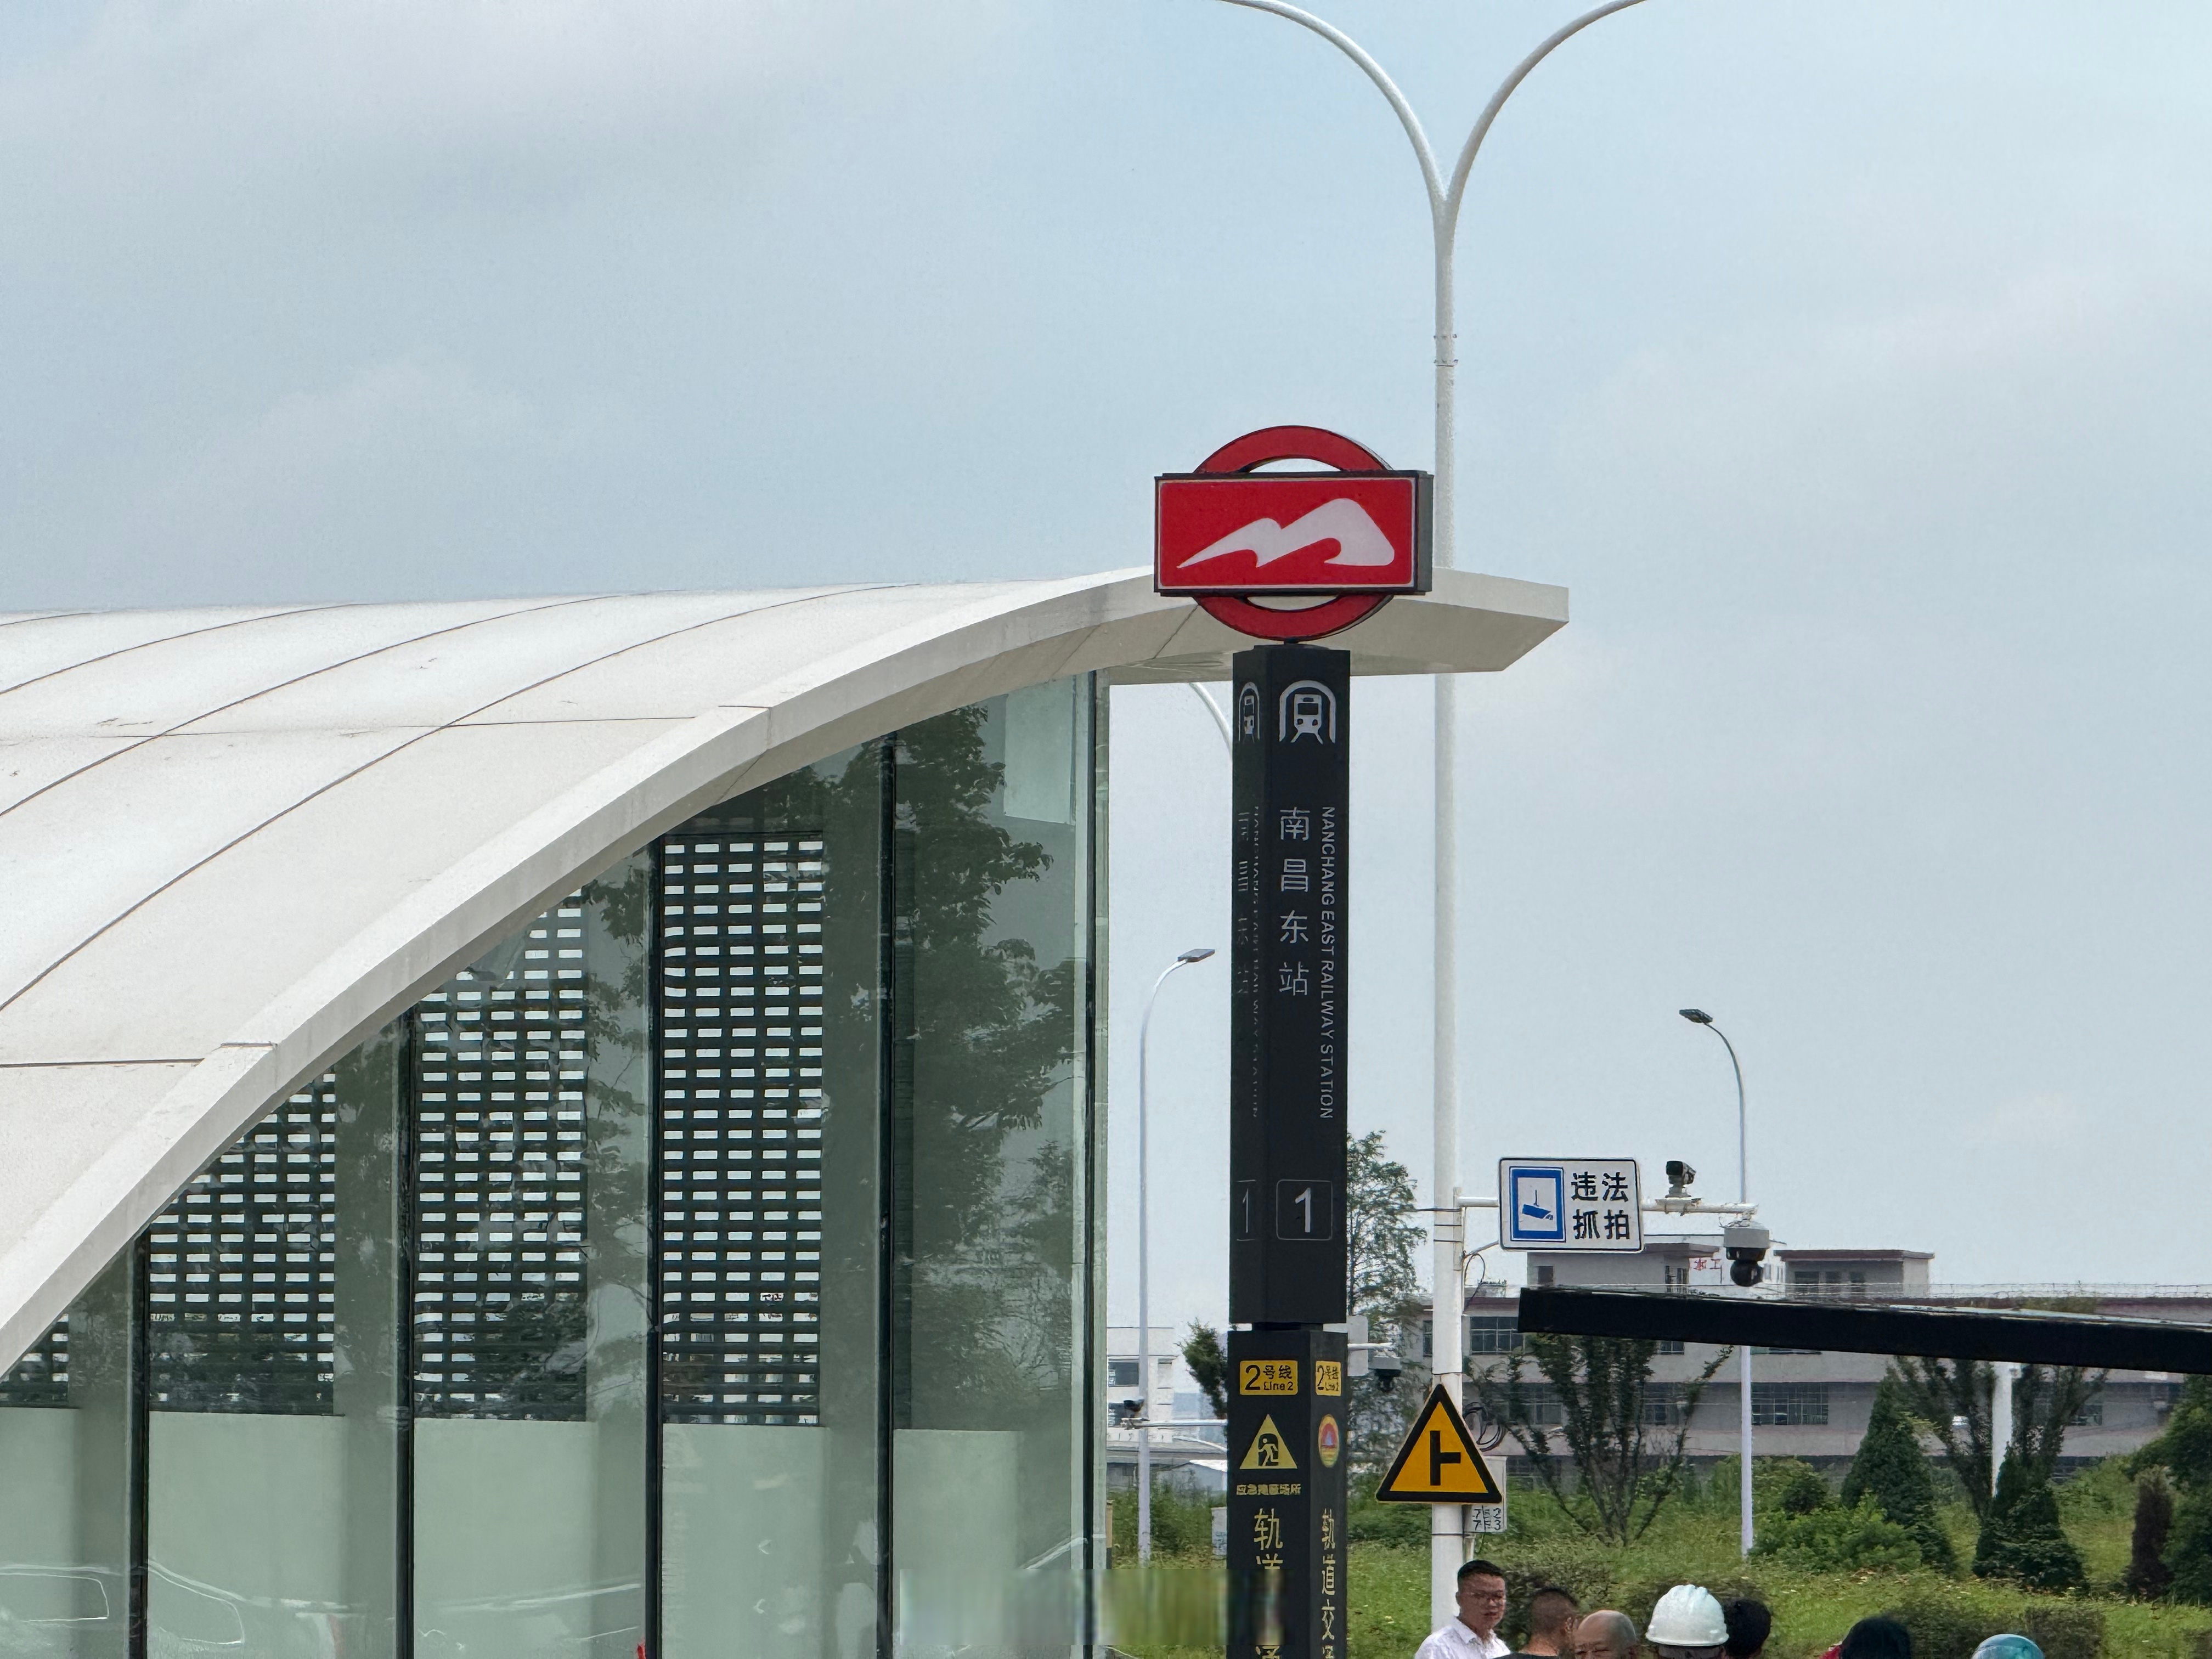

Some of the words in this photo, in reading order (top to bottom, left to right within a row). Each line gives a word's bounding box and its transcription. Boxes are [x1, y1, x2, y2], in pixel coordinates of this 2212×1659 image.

[1321, 806, 1335, 905] NANCHANG
[1279, 806, 1311, 996] 南昌东站
[1321, 910, 1335, 955] EAST
[1320, 960, 1335, 1040] RAILWAY
[1319, 1043, 1334, 1119] STATION
[1571, 1171, 1629, 1202] 违法
[1295, 1187, 1311, 1233] 1
[1572, 1209, 1630, 1239] 抓拍
[1287, 1381, 1294, 1391] 2
